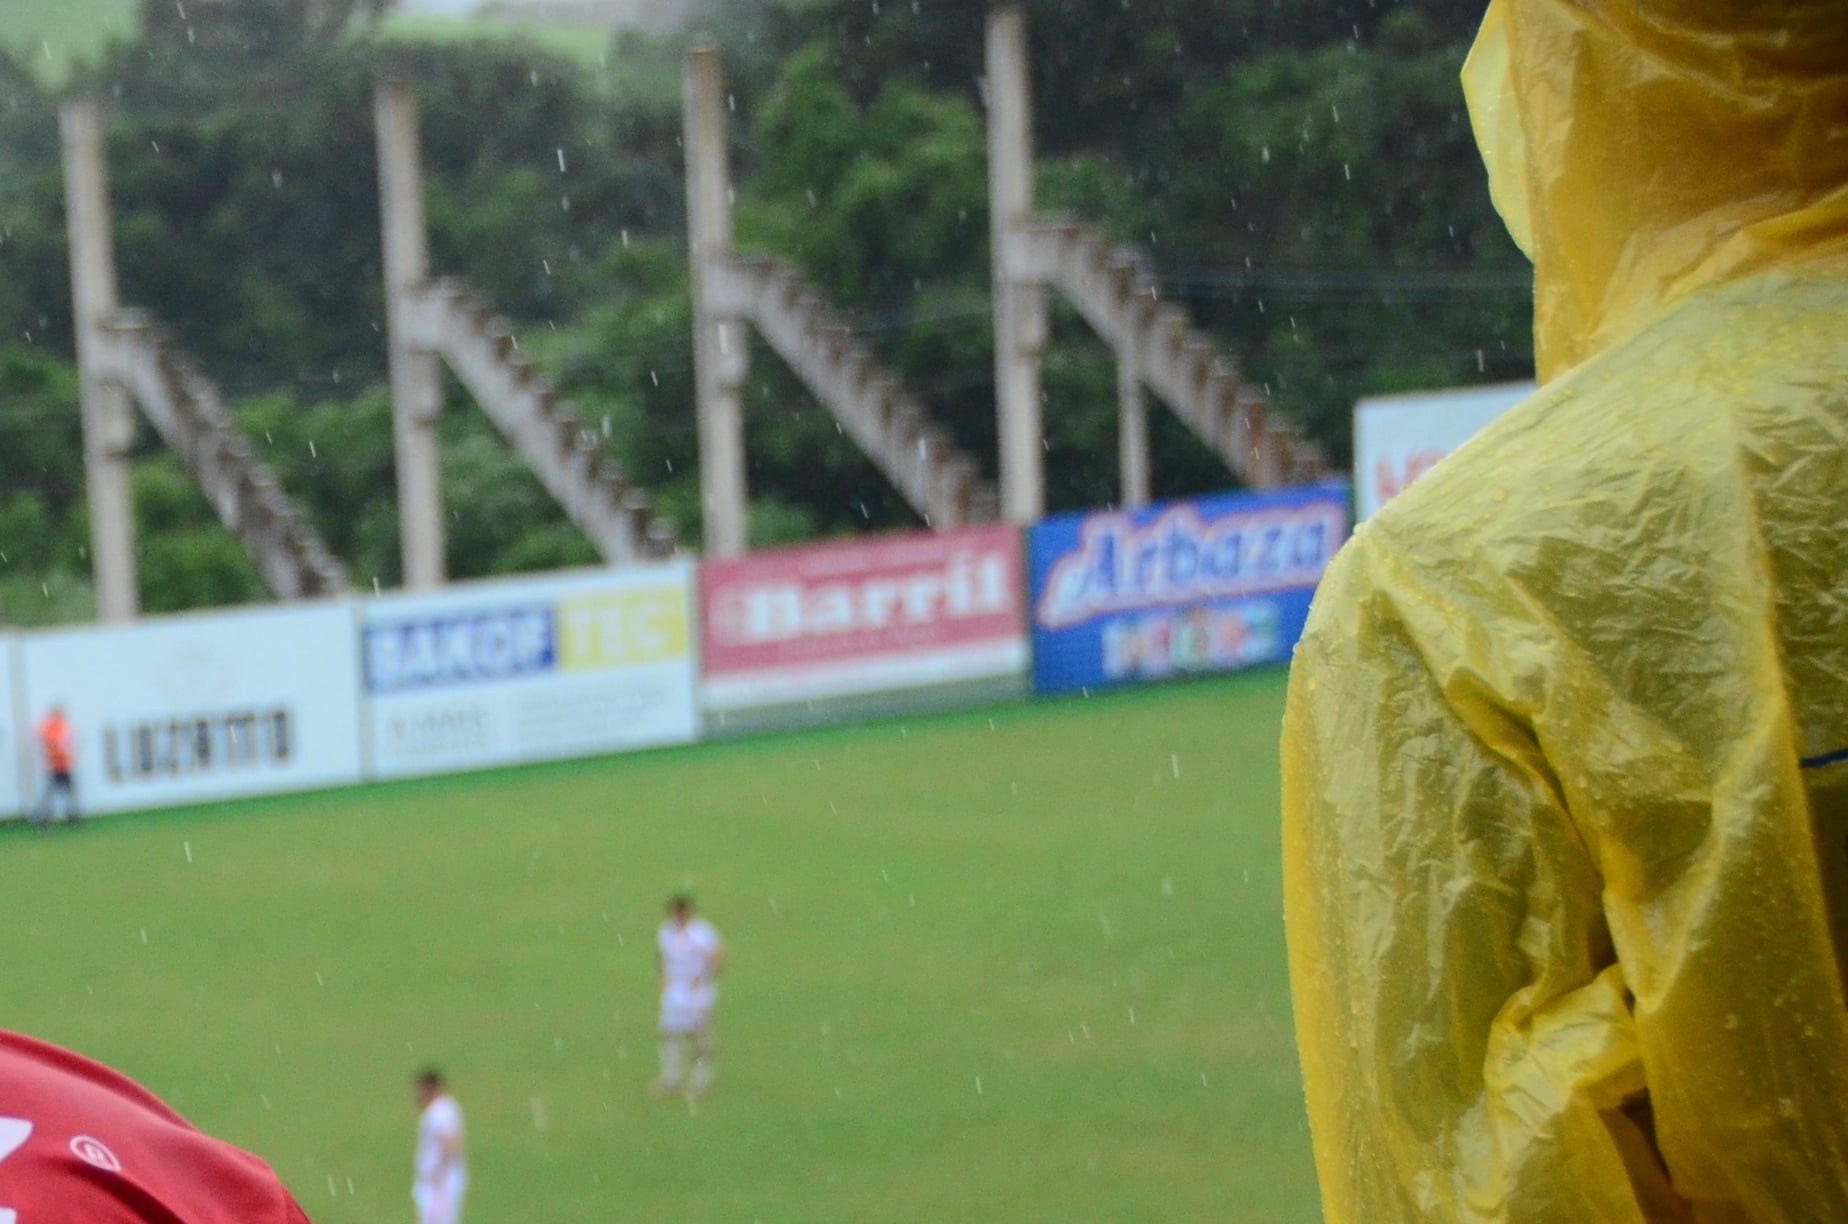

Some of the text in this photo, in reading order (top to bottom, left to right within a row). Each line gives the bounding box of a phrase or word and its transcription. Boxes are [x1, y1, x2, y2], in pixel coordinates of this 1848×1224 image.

[744, 552, 1008, 645] Barril
[1044, 510, 1338, 628] Arbaza
[369, 602, 670, 688] BAKOF TEC
